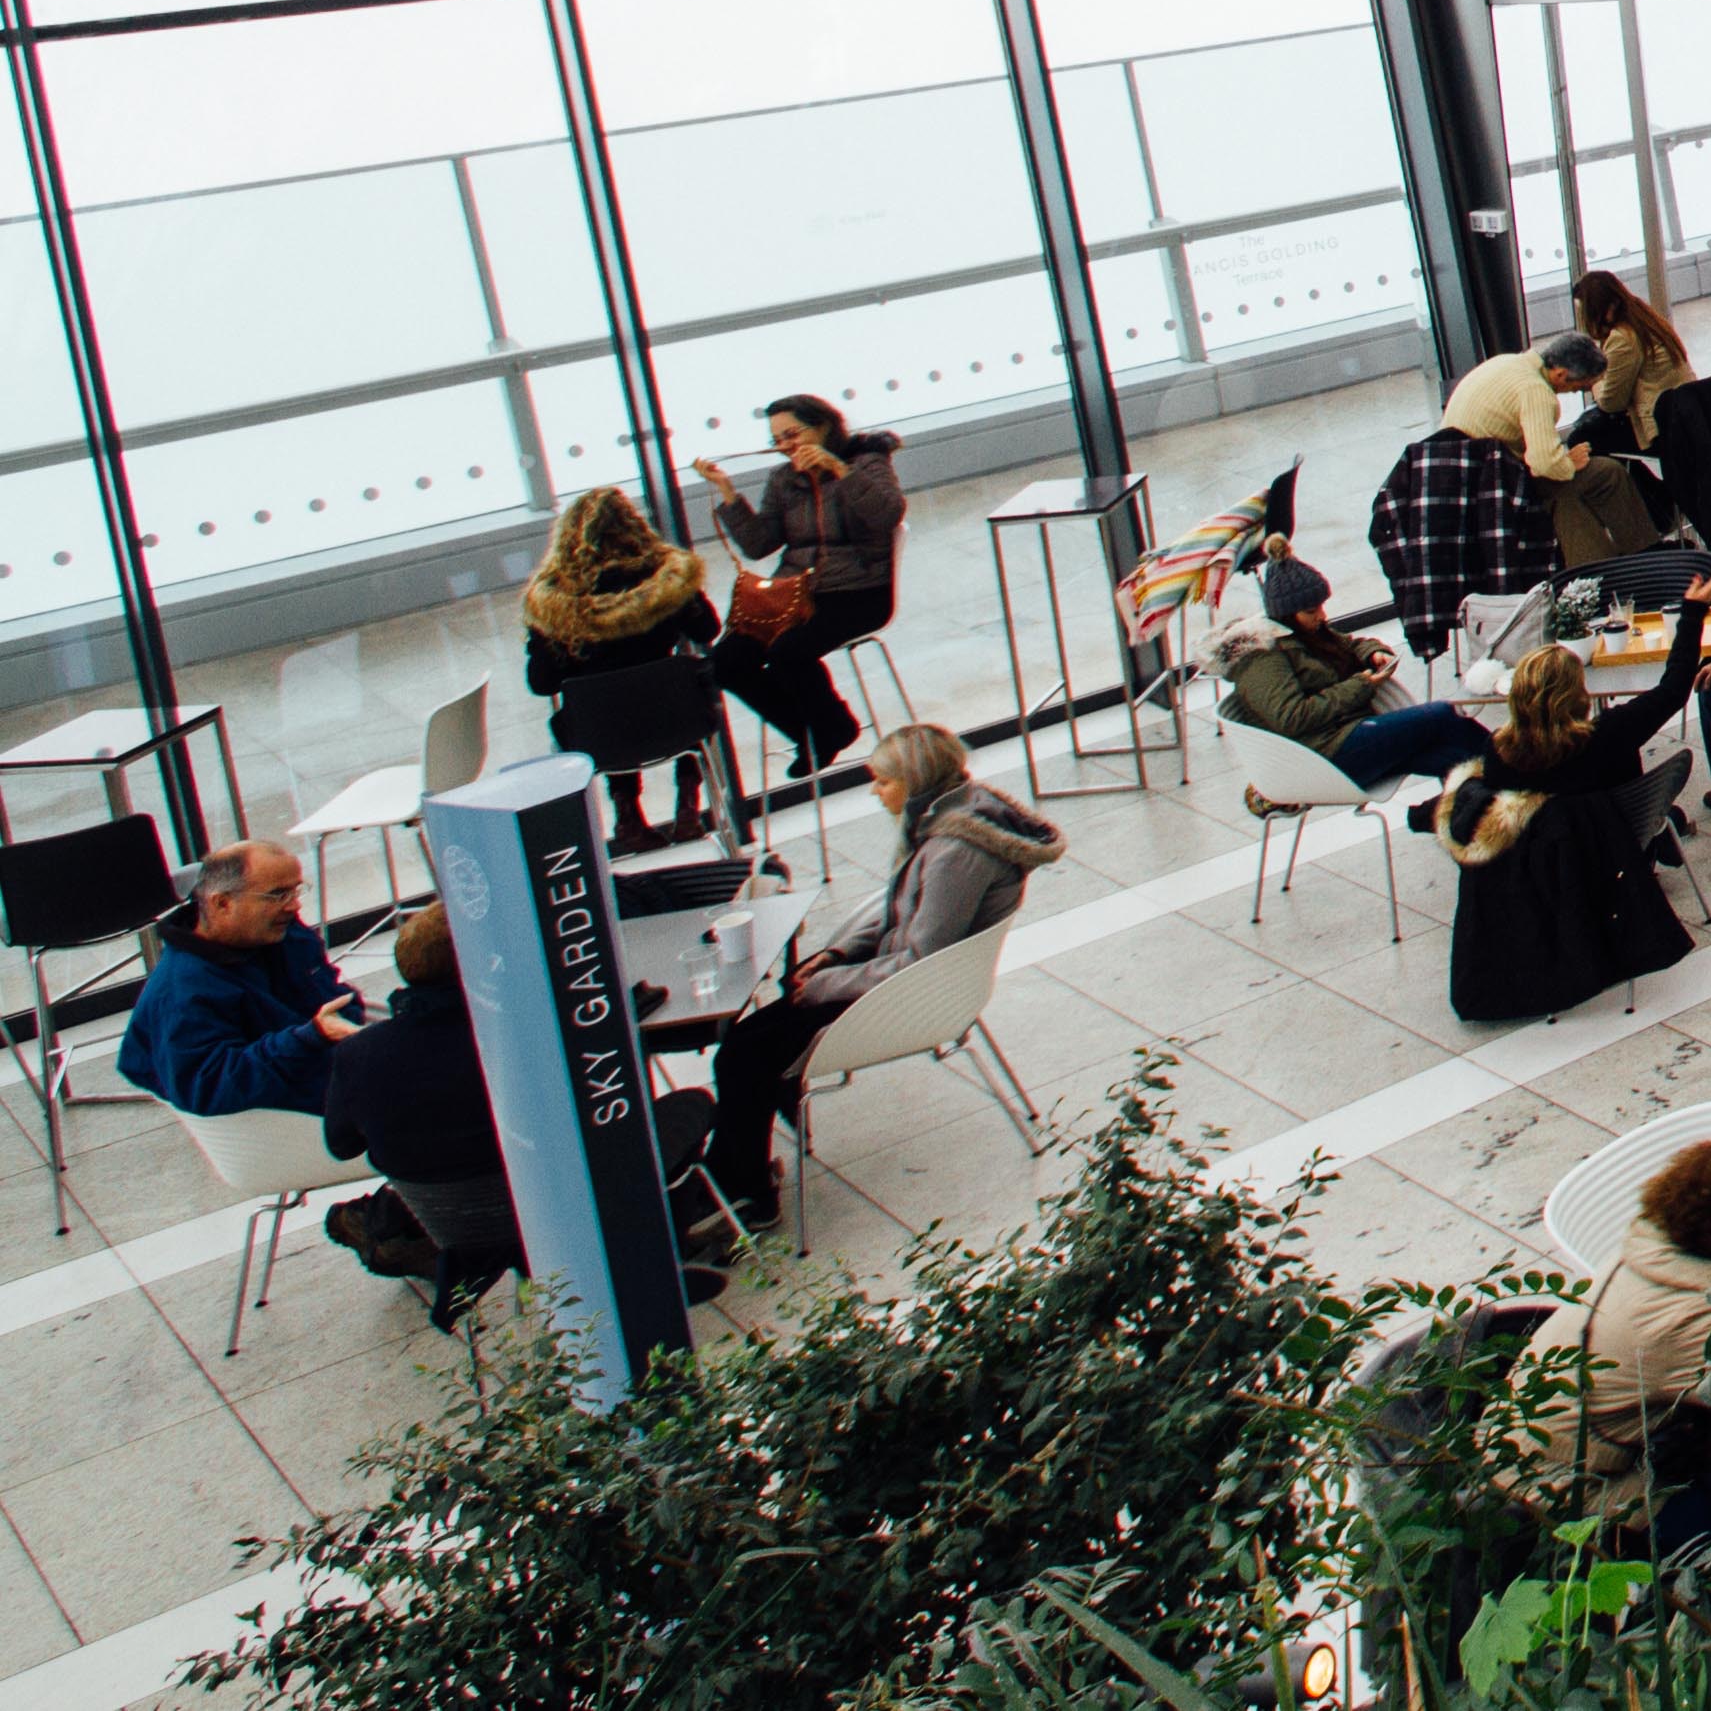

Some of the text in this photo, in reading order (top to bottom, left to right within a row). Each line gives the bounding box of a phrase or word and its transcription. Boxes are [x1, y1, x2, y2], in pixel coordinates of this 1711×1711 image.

[1193, 236, 1340, 277] ANCIS GOLDING
[1239, 235, 1265, 248] The
[1233, 267, 1284, 288] Terrace
[544, 845, 631, 1127] SKY GARDEN
